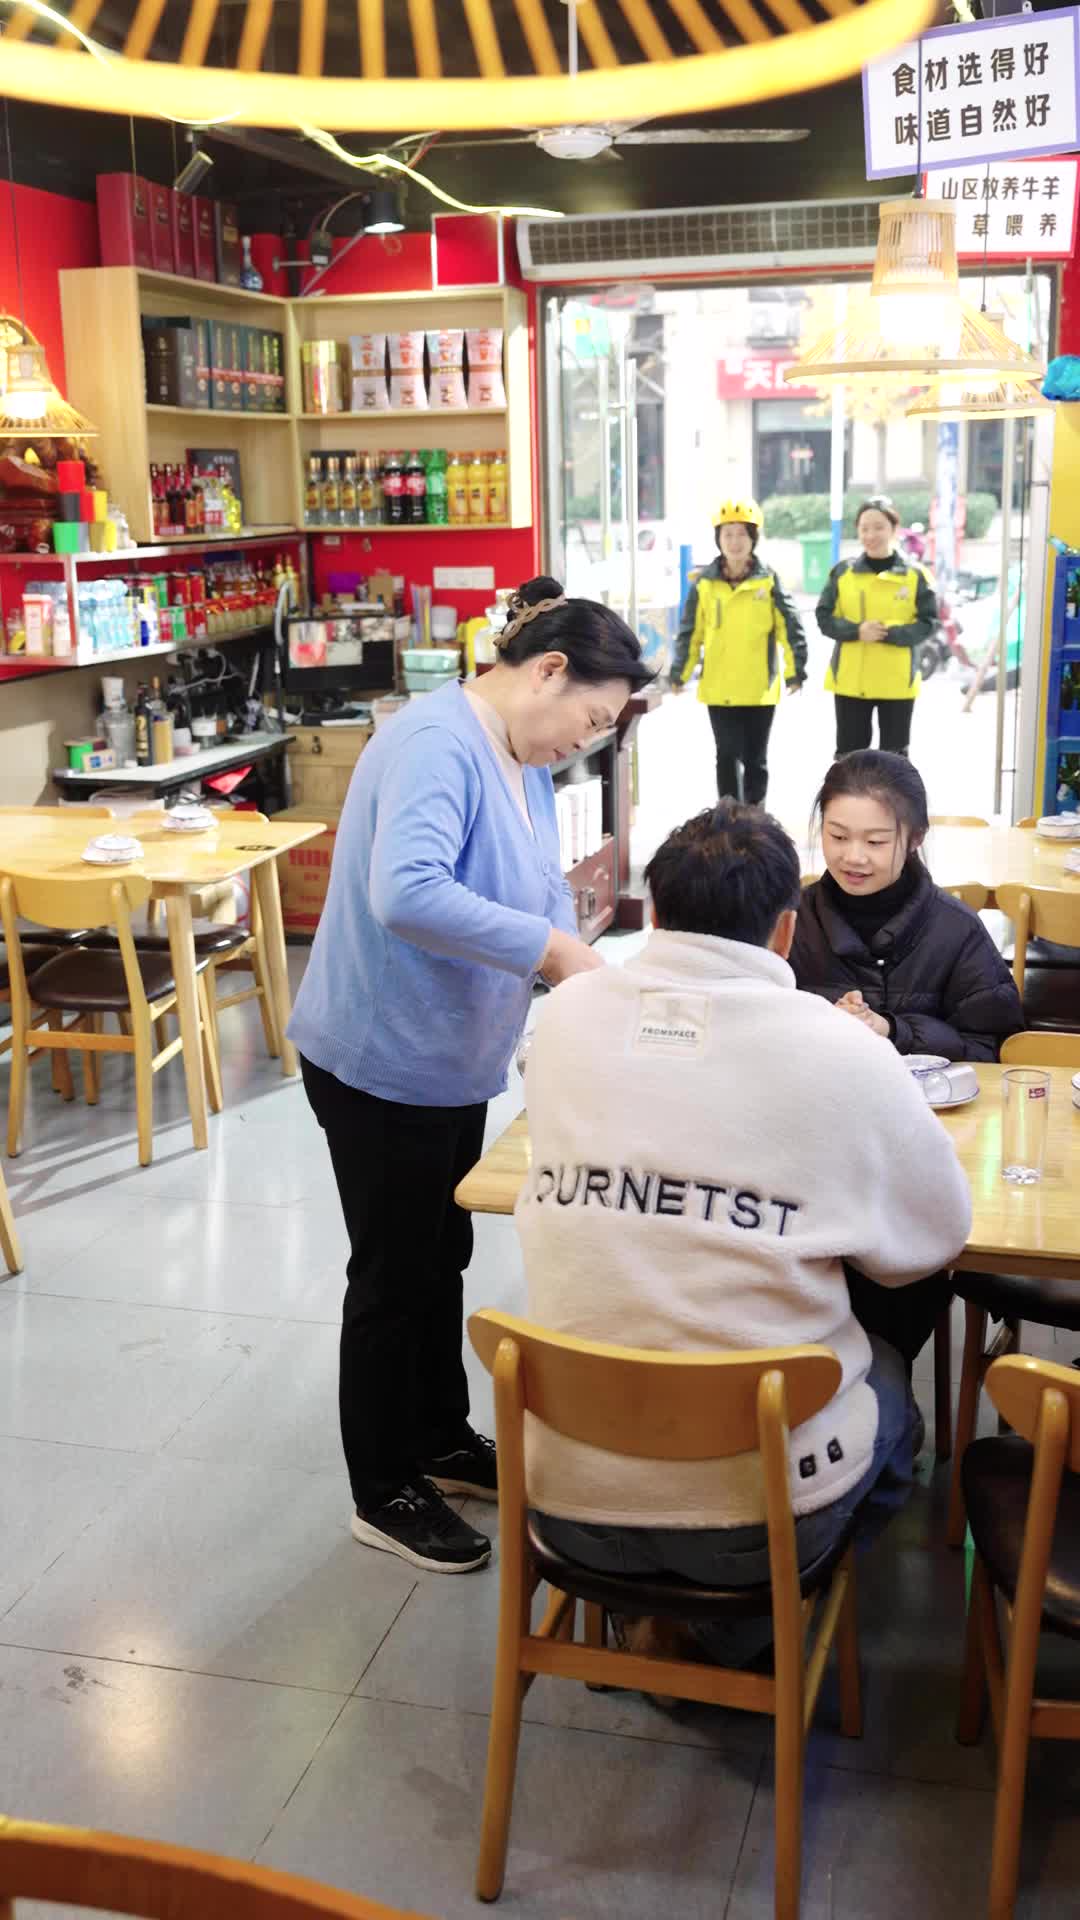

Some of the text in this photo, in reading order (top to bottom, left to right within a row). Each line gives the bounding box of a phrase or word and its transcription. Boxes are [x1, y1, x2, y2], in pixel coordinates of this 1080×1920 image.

[892, 41, 1049, 97] 食材选得好
[894, 93, 1051, 146] 味道自然好
[941, 175, 1060, 201] 山区放养牛羊
